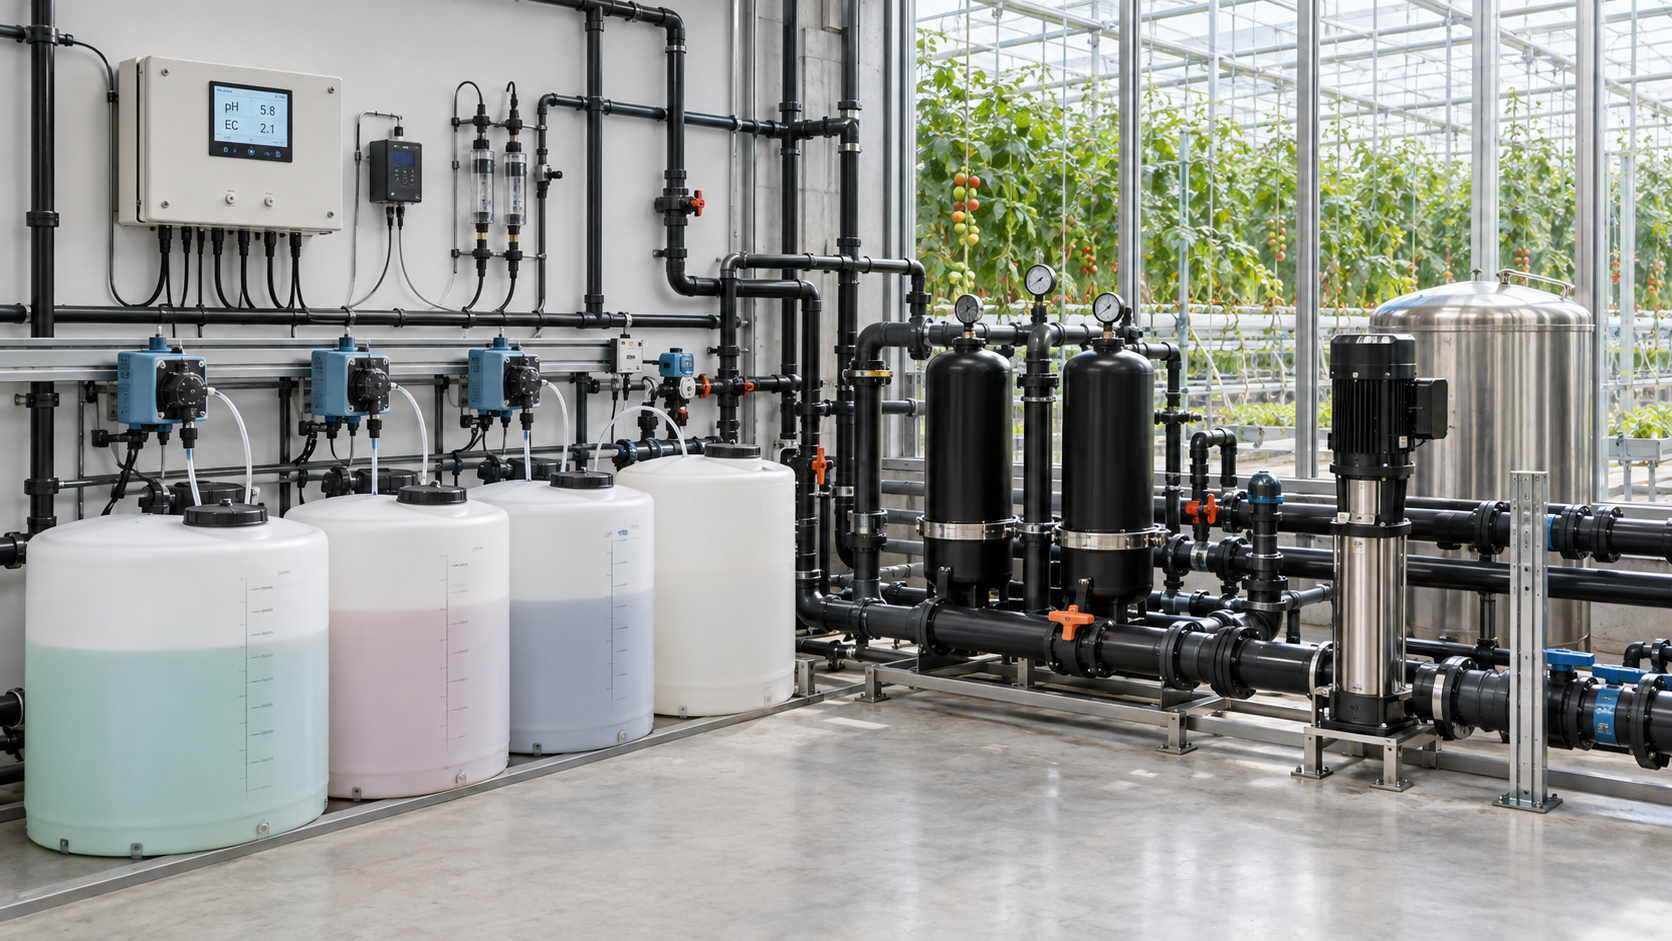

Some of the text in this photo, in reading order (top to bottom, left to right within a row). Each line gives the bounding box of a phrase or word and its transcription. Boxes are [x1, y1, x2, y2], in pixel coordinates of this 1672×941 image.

[224, 101, 276, 116] pH 5.8
[225, 119, 274, 134] EC 2.1
